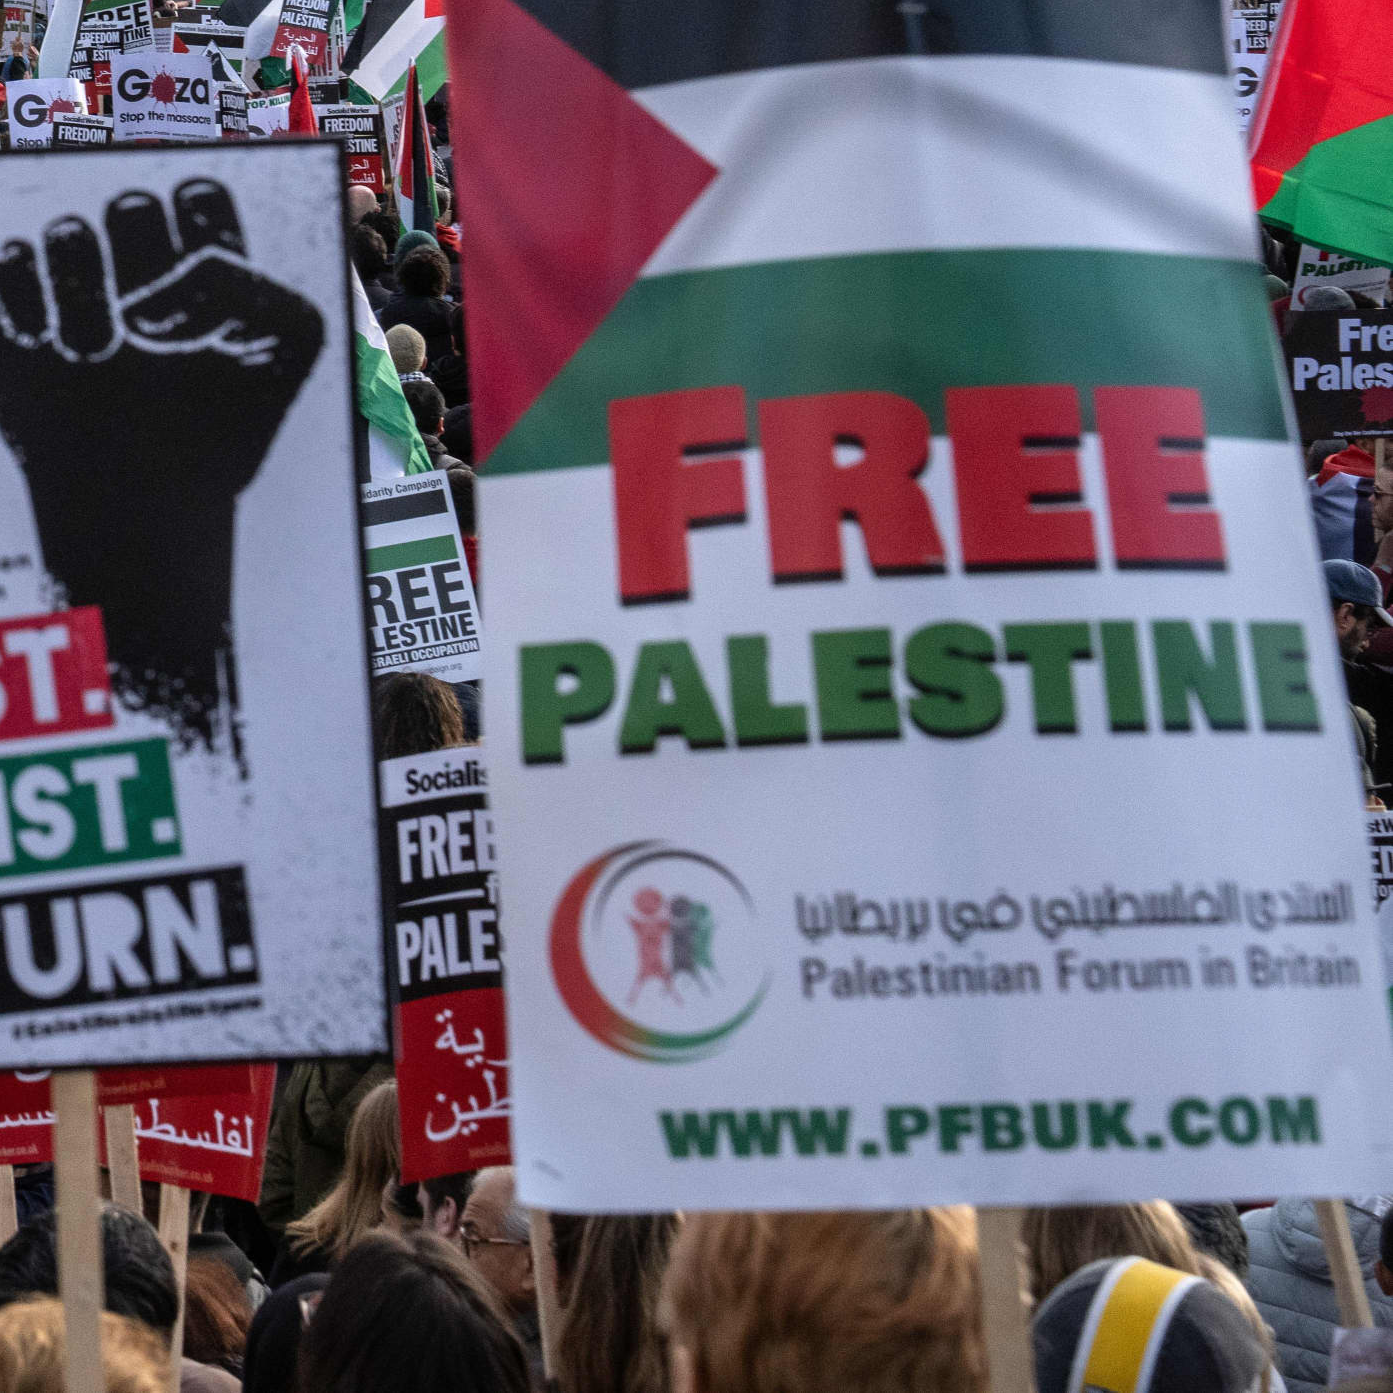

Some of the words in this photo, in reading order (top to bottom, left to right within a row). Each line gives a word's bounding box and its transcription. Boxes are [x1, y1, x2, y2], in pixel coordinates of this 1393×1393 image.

[117, 68, 210, 106] Gza
[119, 112, 145, 126] Stop
[147, 111, 165, 125] the
[167, 114, 212, 126] massacre
[395, 476, 443, 495] Campaign
[609, 383, 1228, 607] FREE
[366, 561, 471, 627] REE
[411, 638, 480, 662] OCCUPATION
[518, 620, 1324, 767] PALESTINE
[800, 953, 1042, 1004] Palestinian
[1055, 948, 1192, 994] Forum
[1200, 943, 1234, 991] in
[1247, 943, 1361, 990] Britain
[659, 1095, 1323, 1160] WWW.PFBUK.COM
